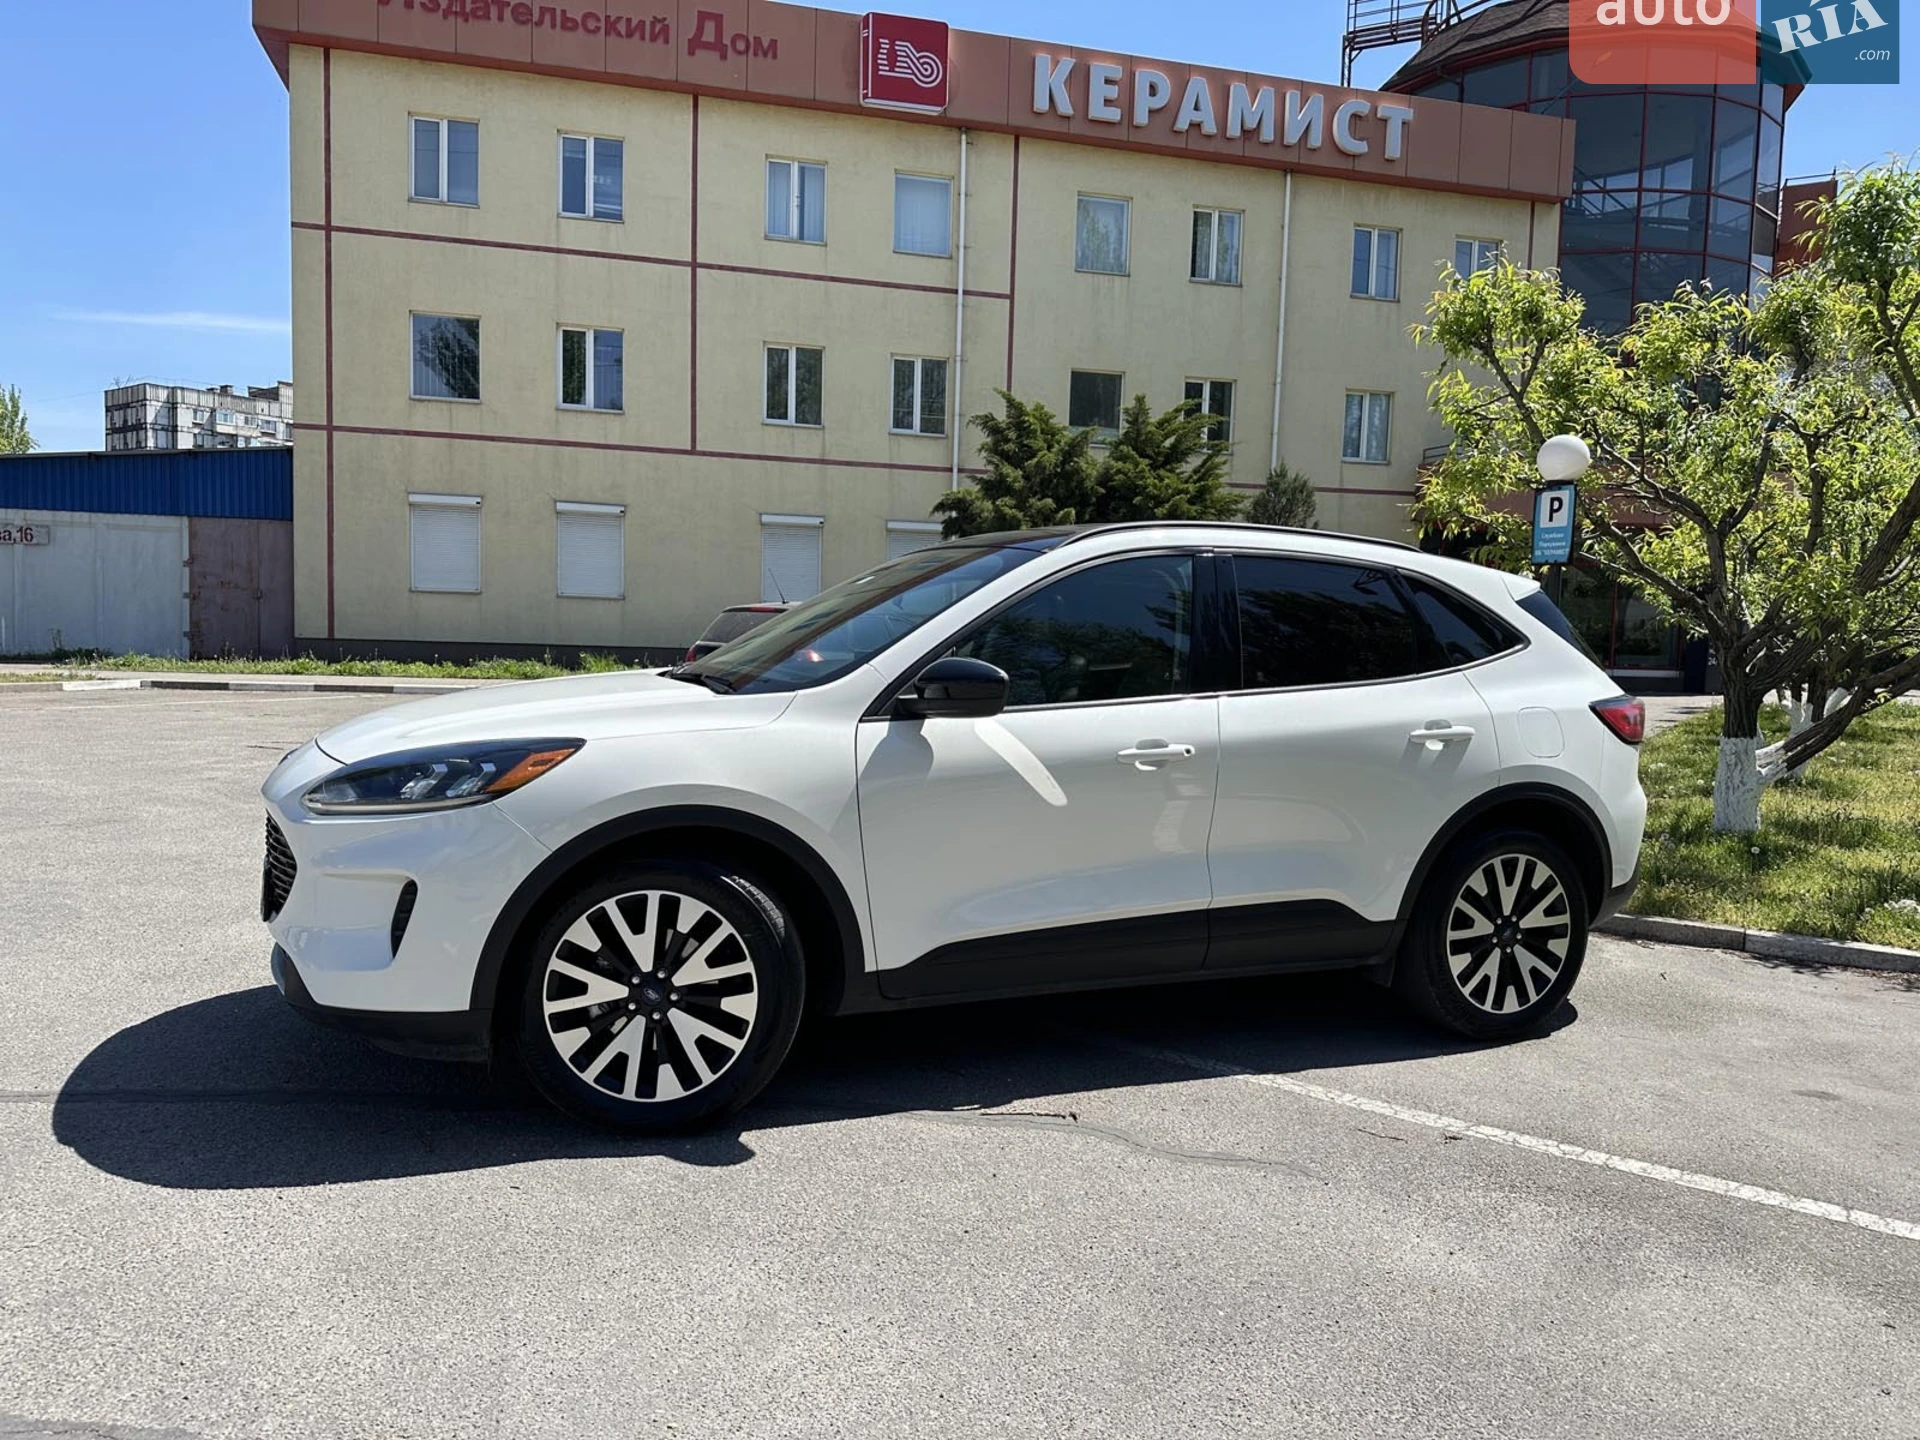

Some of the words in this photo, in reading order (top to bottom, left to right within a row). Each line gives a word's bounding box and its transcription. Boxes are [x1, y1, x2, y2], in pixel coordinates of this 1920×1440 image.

[378, 0, 670, 45] здательский
[687, 10, 779, 61] Дом
[1033, 53, 1414, 161] КЕРАМИСТ
[1548, 496, 1564, 523] P
